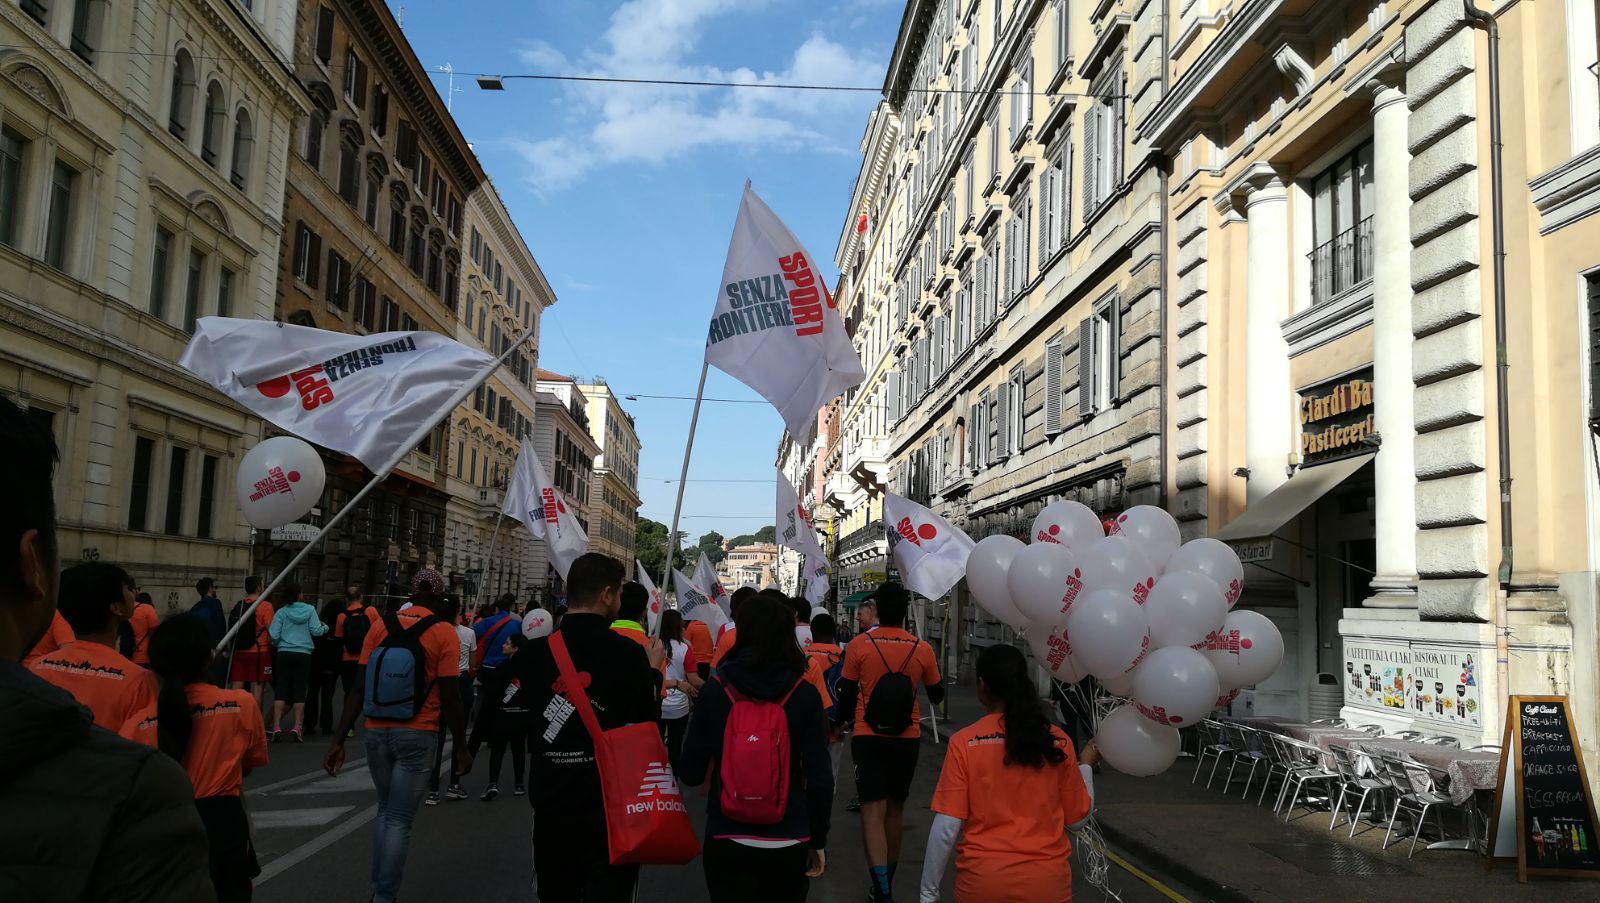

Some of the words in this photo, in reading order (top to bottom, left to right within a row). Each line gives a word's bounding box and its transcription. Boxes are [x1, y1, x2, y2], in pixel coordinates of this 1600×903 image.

[726, 273, 789, 309] SENZA
[779, 251, 824, 337] SPORT
[706, 301, 795, 348] RONTIERE
[324, 356, 384, 382] SENZA
[1349, 379, 1374, 410] Ba
[1301, 413, 1375, 455] Pasticceri
[254, 477, 275, 491] SENZA
[268, 466, 292, 494] SPORT
[543, 488, 559, 524] SPORT
[542, 701, 576, 744] FRONTIERE
[543, 694, 566, 722] SENZA
[626, 801, 654, 815] new
